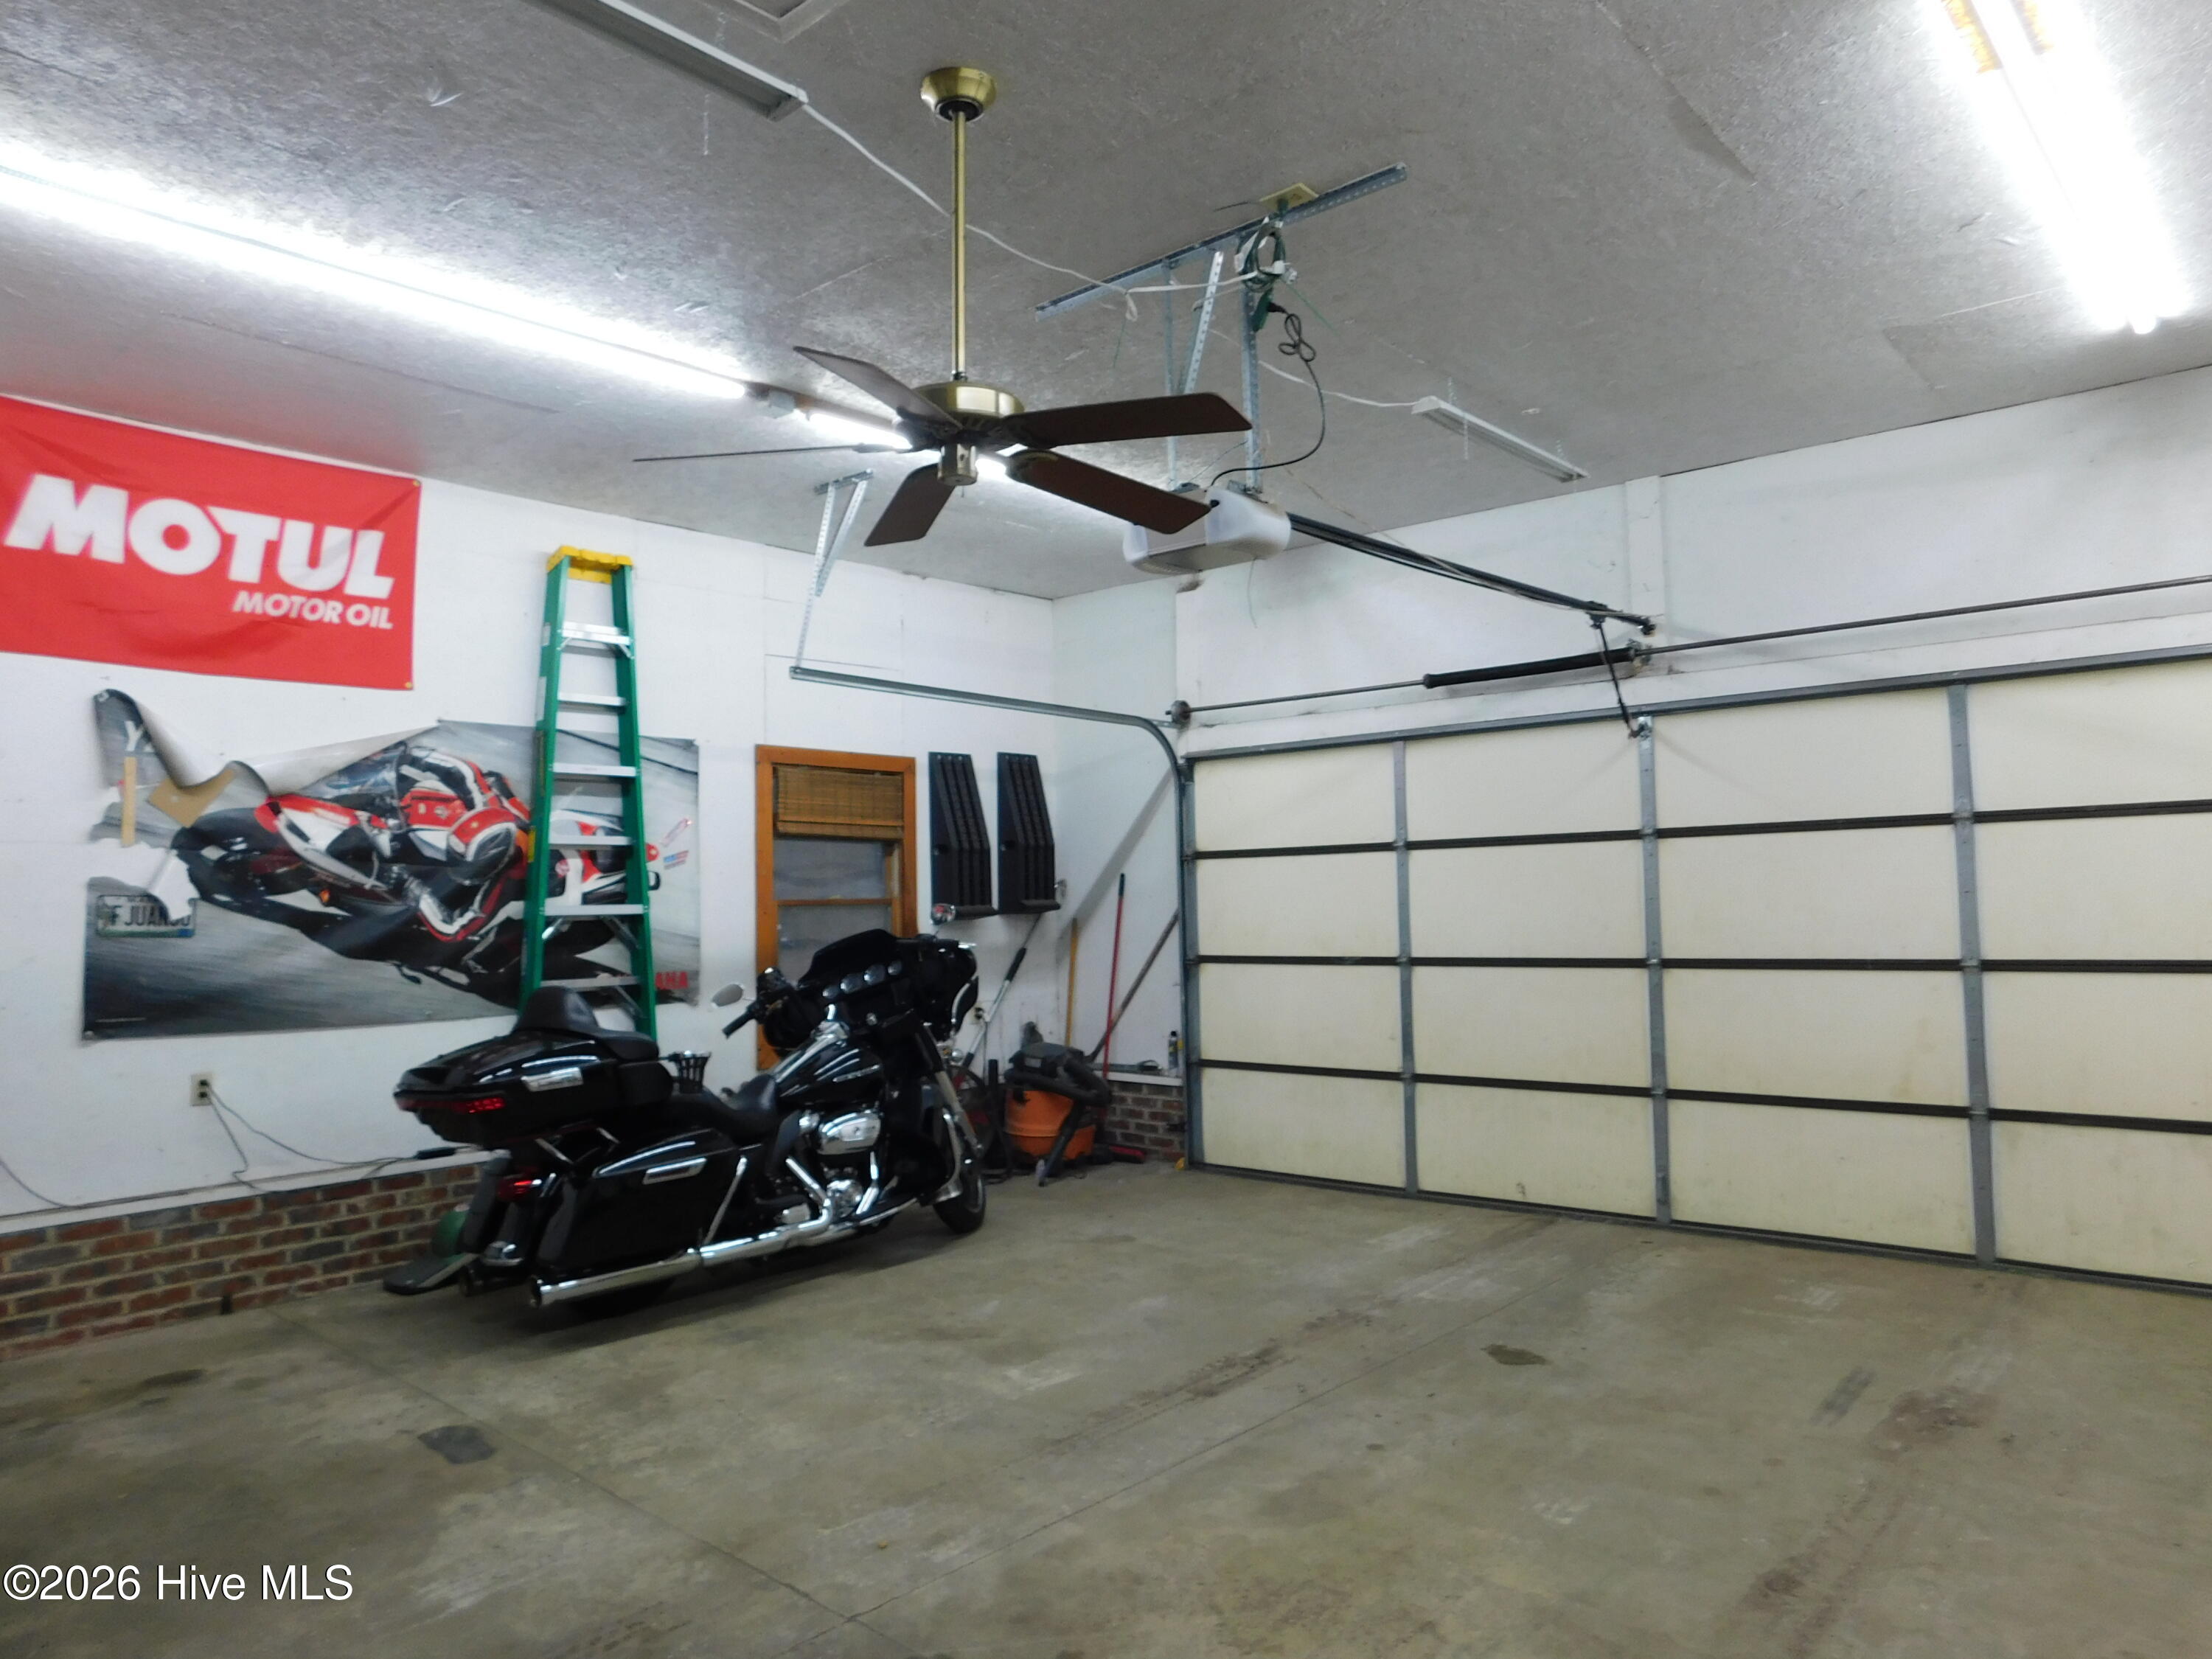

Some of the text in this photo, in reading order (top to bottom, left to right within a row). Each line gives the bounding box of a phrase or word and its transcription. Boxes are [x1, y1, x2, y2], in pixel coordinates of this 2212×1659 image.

[4, 473, 394, 599] MOTUL
[232, 590, 394, 630] MOTOR OIL
